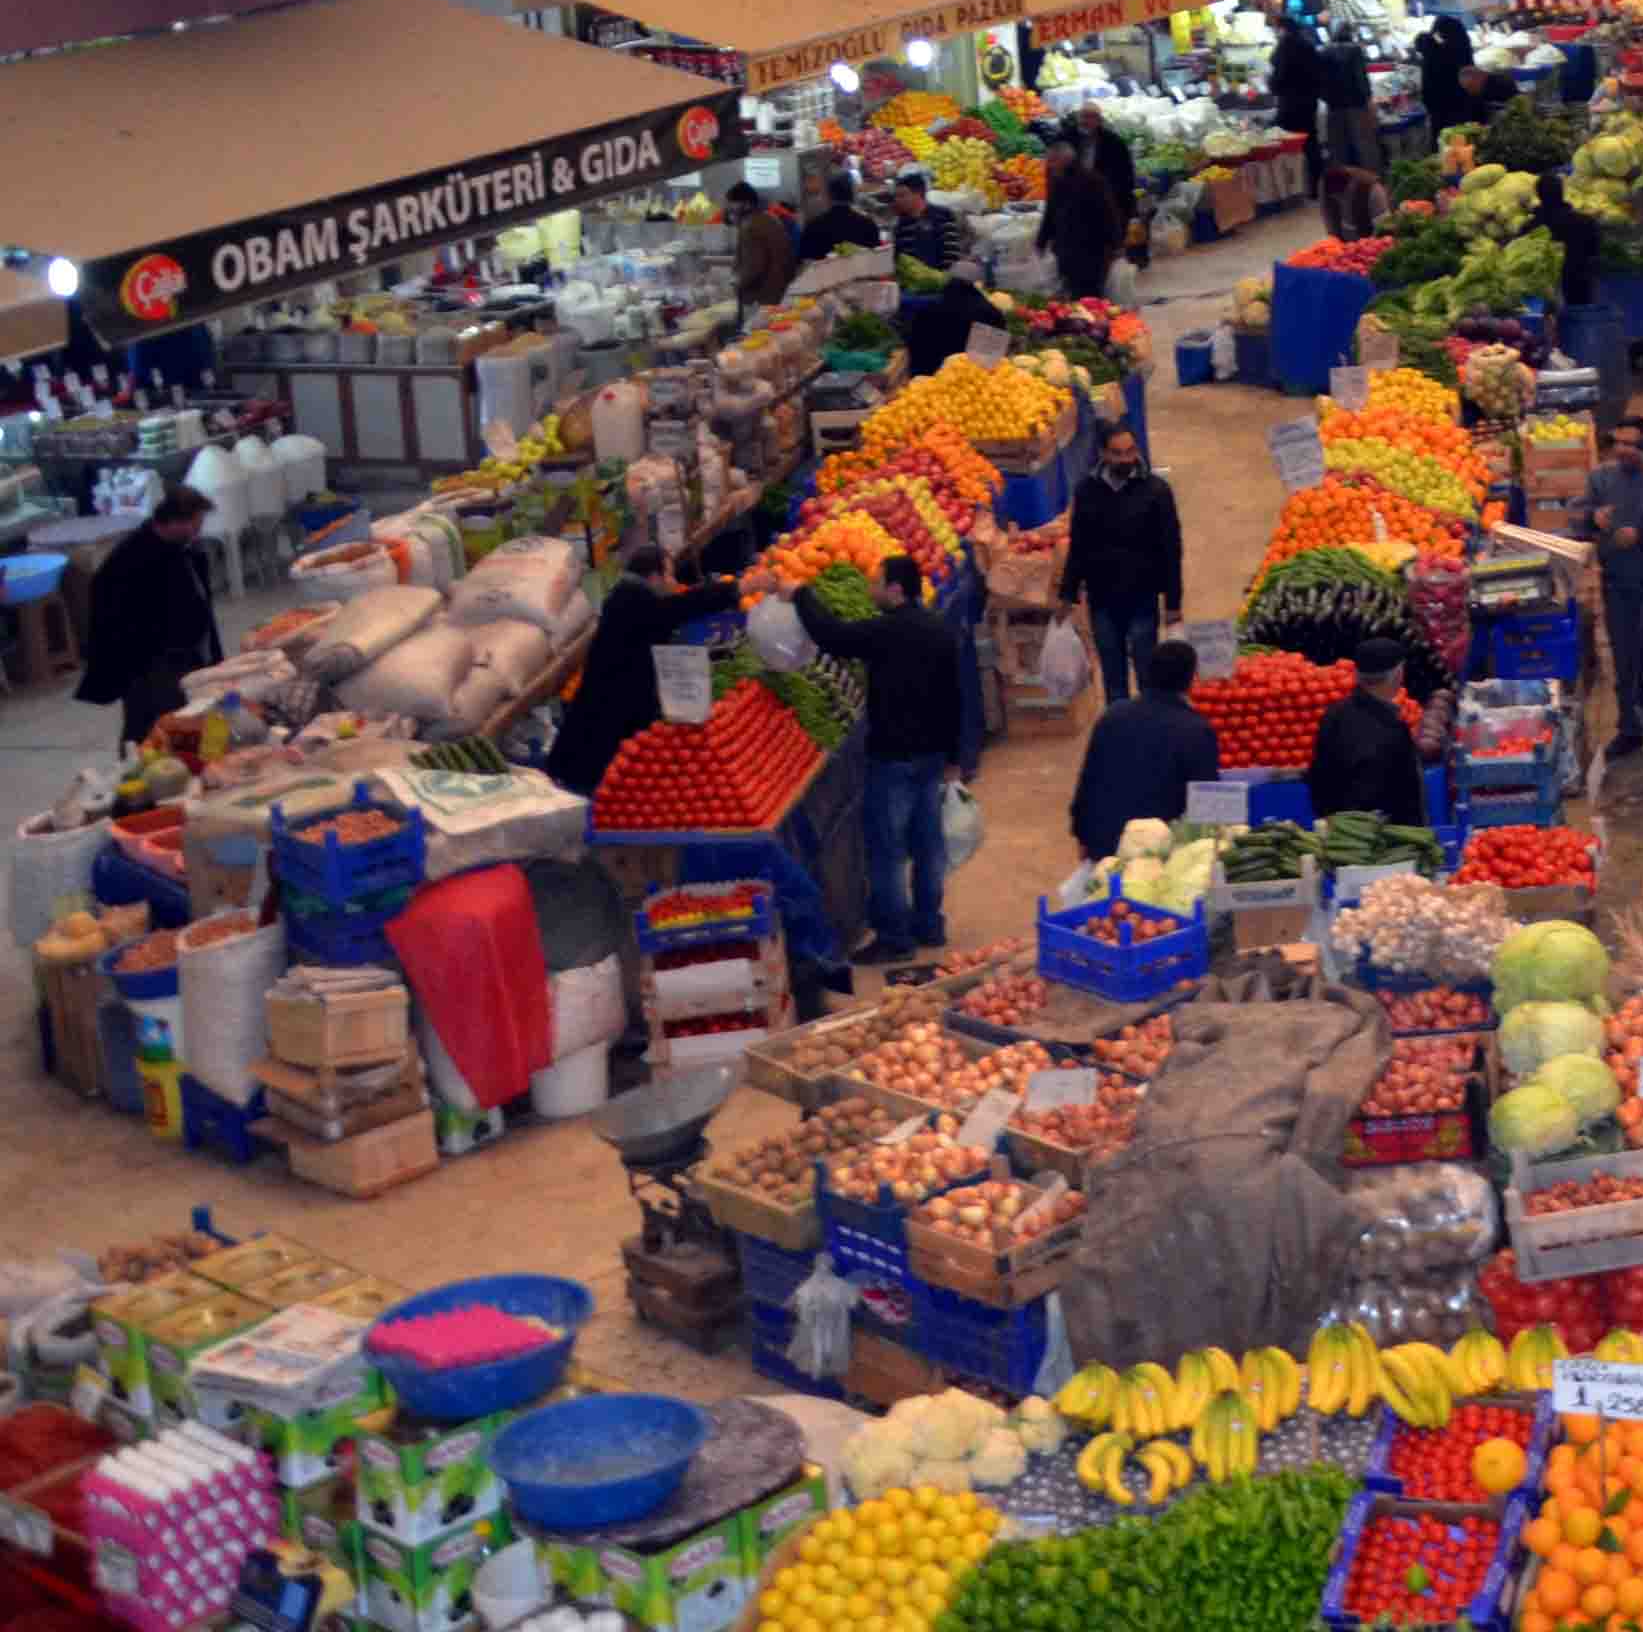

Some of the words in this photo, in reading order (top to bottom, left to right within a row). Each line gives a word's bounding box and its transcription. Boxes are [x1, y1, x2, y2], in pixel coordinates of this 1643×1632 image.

[1039, 0, 1125, 43] ERMAN
[212, 215, 341, 293] OBAM
[348, 162, 546, 265] ŞARKÜTERİ
[551, 154, 575, 193] &
[580, 129, 661, 185] GIDA
